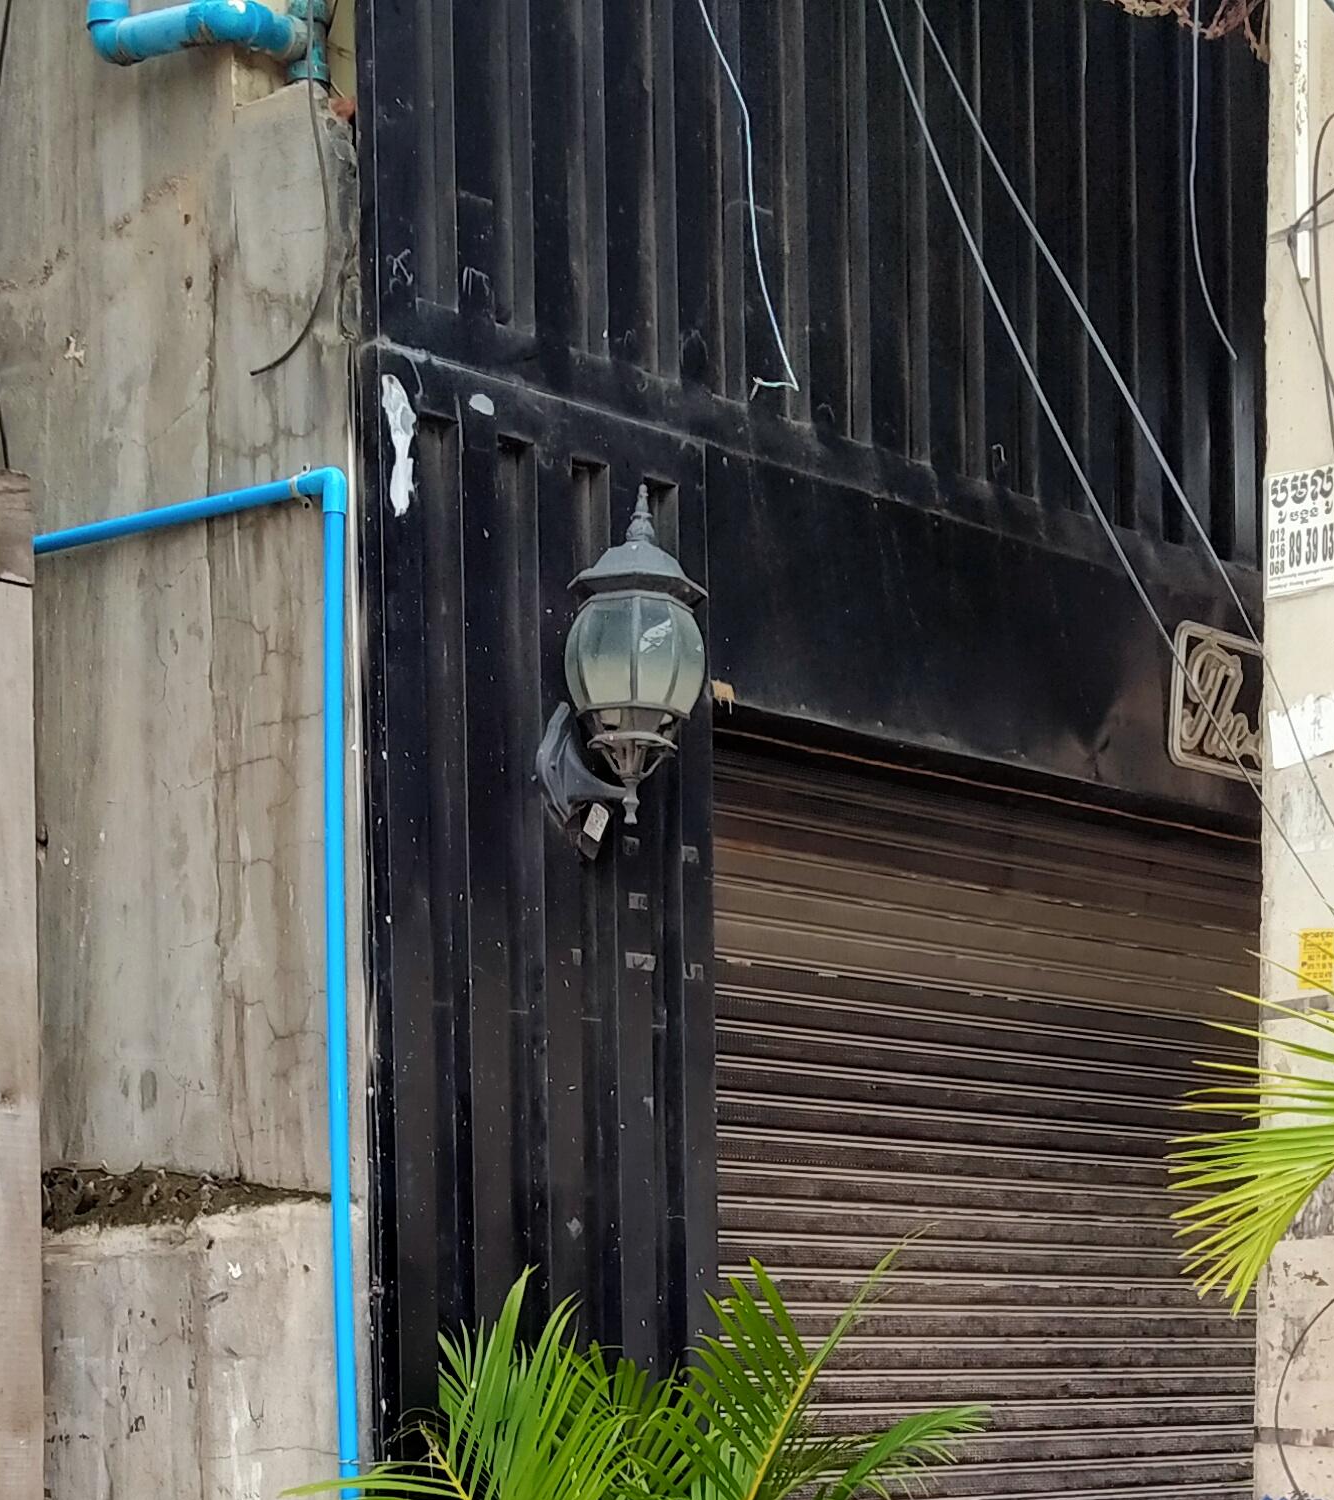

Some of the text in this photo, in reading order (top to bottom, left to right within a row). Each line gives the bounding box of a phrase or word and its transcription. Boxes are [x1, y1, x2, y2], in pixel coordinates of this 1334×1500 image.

[1269, 522, 1334, 568] 012 89 39 03
